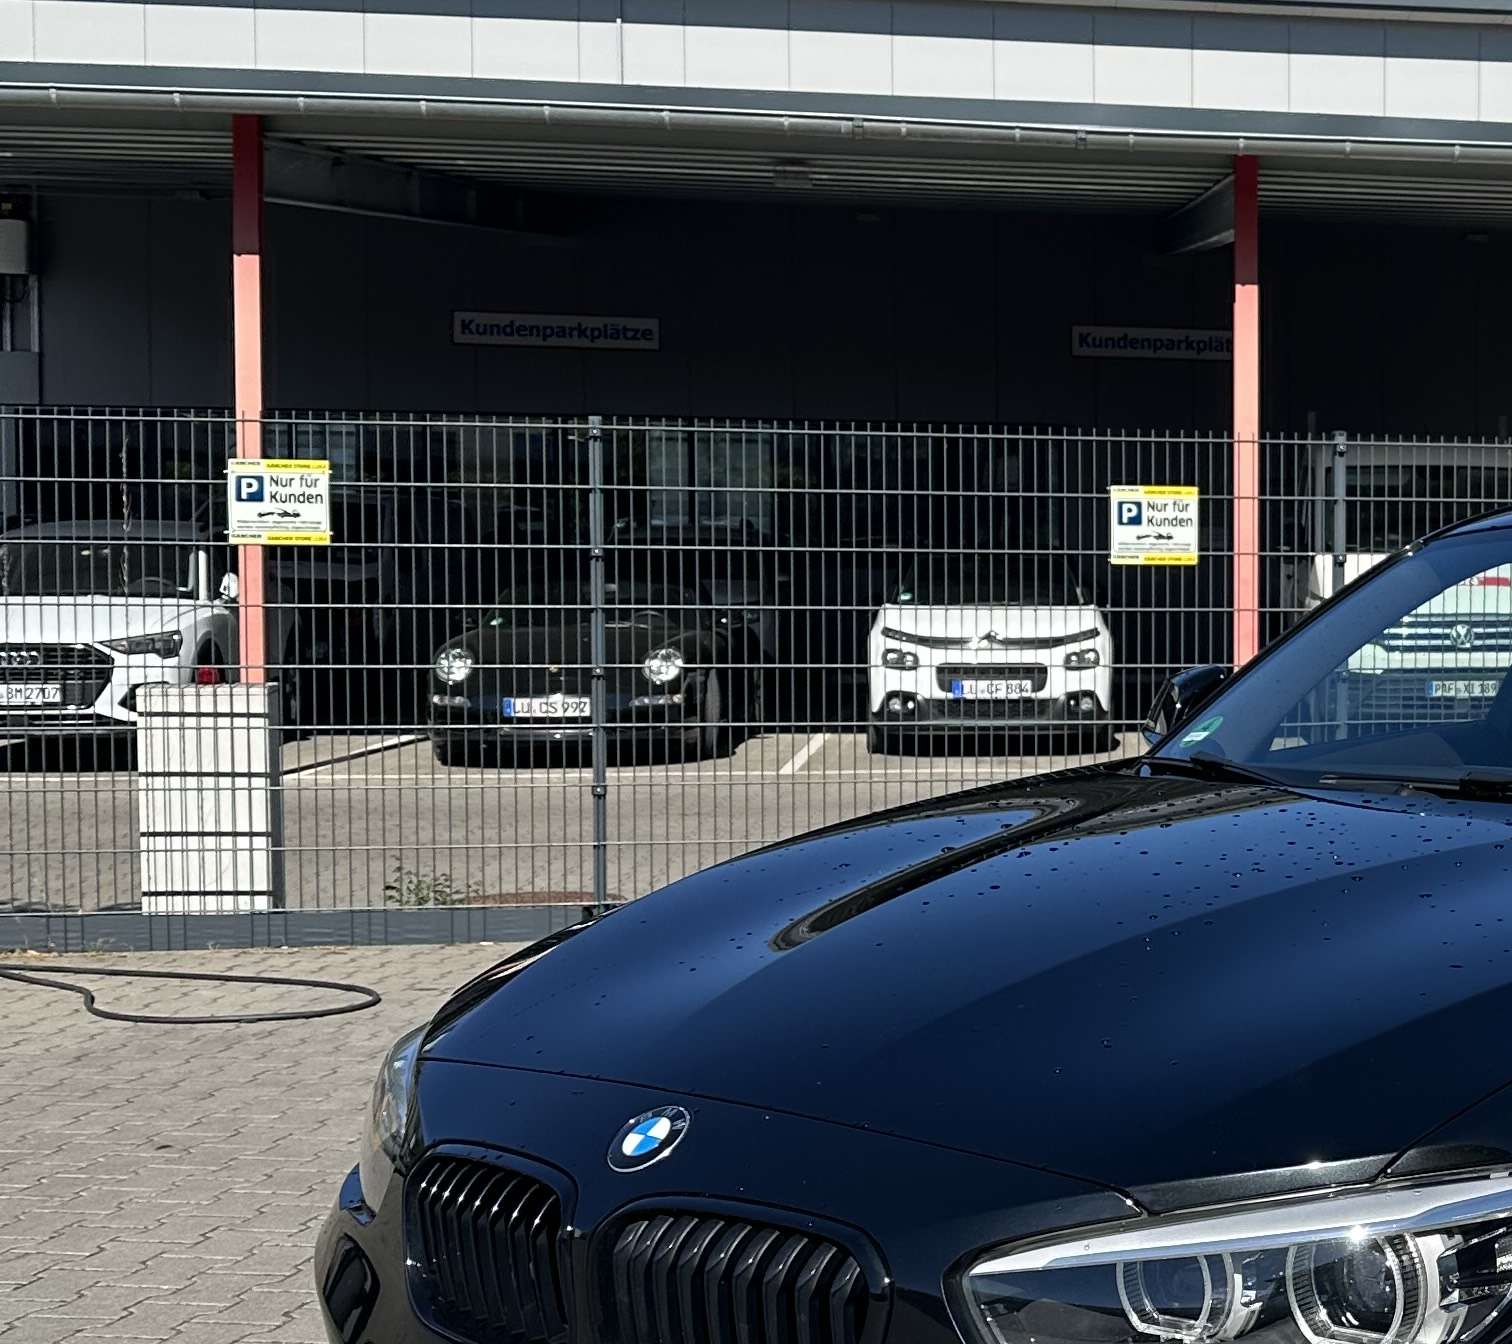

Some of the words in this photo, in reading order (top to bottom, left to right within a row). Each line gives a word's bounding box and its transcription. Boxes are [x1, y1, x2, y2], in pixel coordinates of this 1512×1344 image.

[460, 319, 655, 342] Kundenparkplätze
[1078, 332, 1233, 355] Kundenparkplät
[269, 475, 295, 488] Nur
[299, 474, 320, 488] für
[269, 491, 324, 504] Kunden
[1146, 500, 1169, 513] Nur
[1173, 499, 1191, 513] für
[1146, 515, 1193, 527] Kunden
